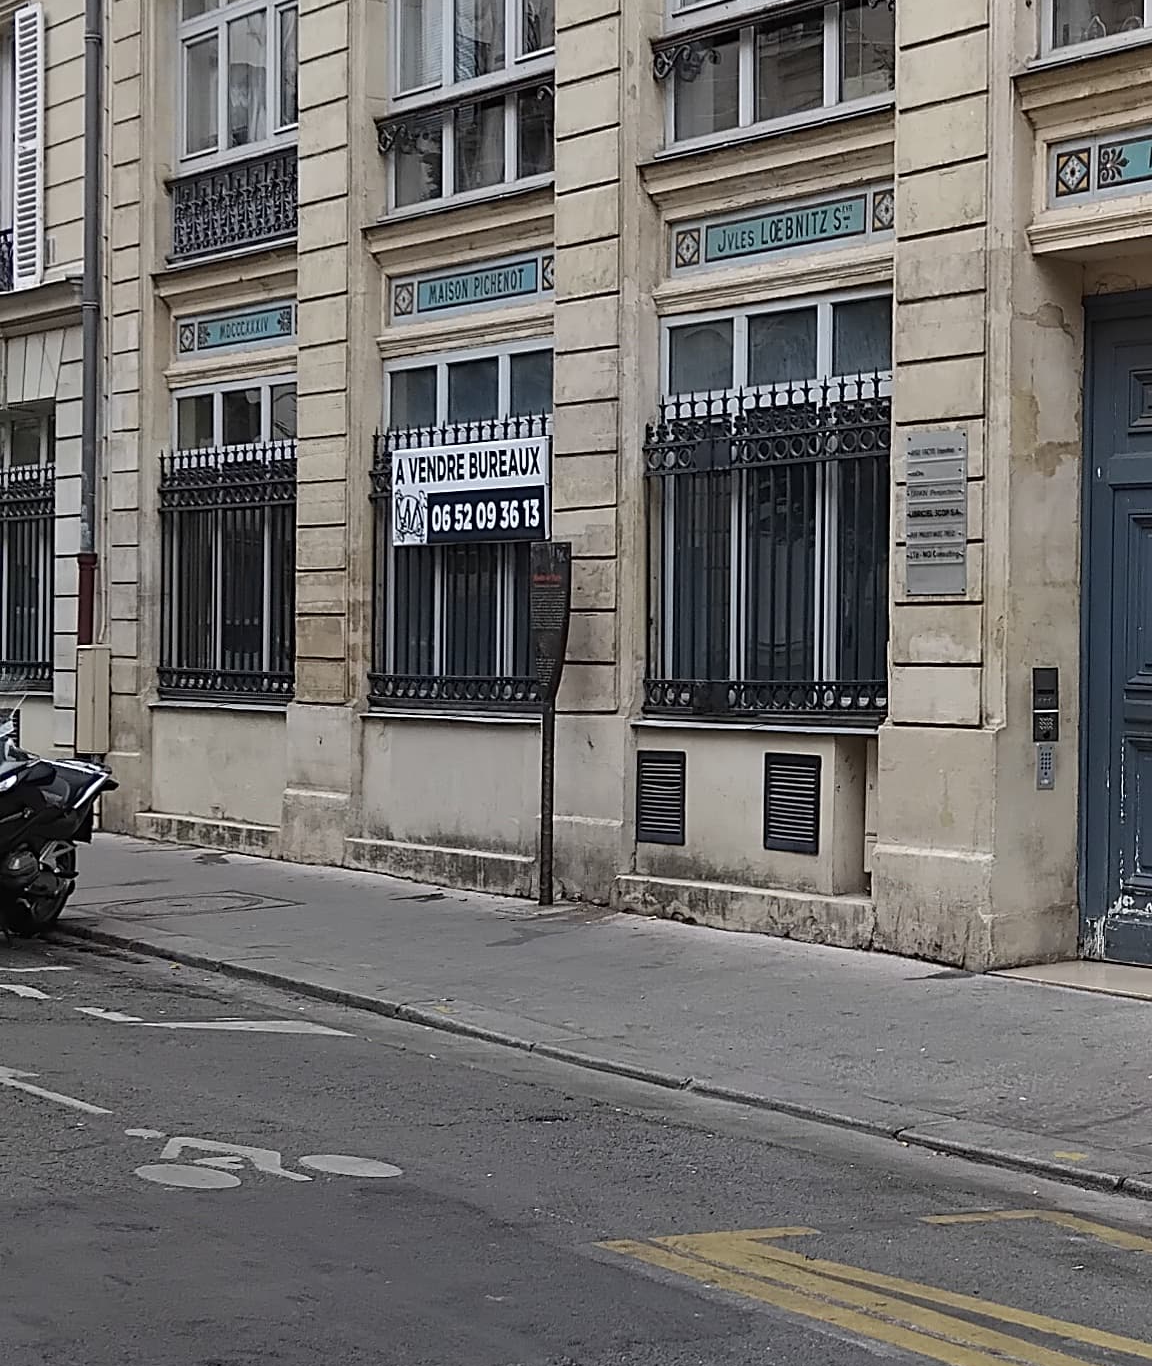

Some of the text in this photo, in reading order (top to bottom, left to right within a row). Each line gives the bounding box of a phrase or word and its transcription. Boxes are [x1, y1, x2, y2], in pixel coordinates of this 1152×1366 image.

[428, 268, 525, 306] MAISON PICHENOT
[395, 446, 541, 485] A VENDRE BUREAUX
[431, 498, 541, 533] 06 52 09 36 13
